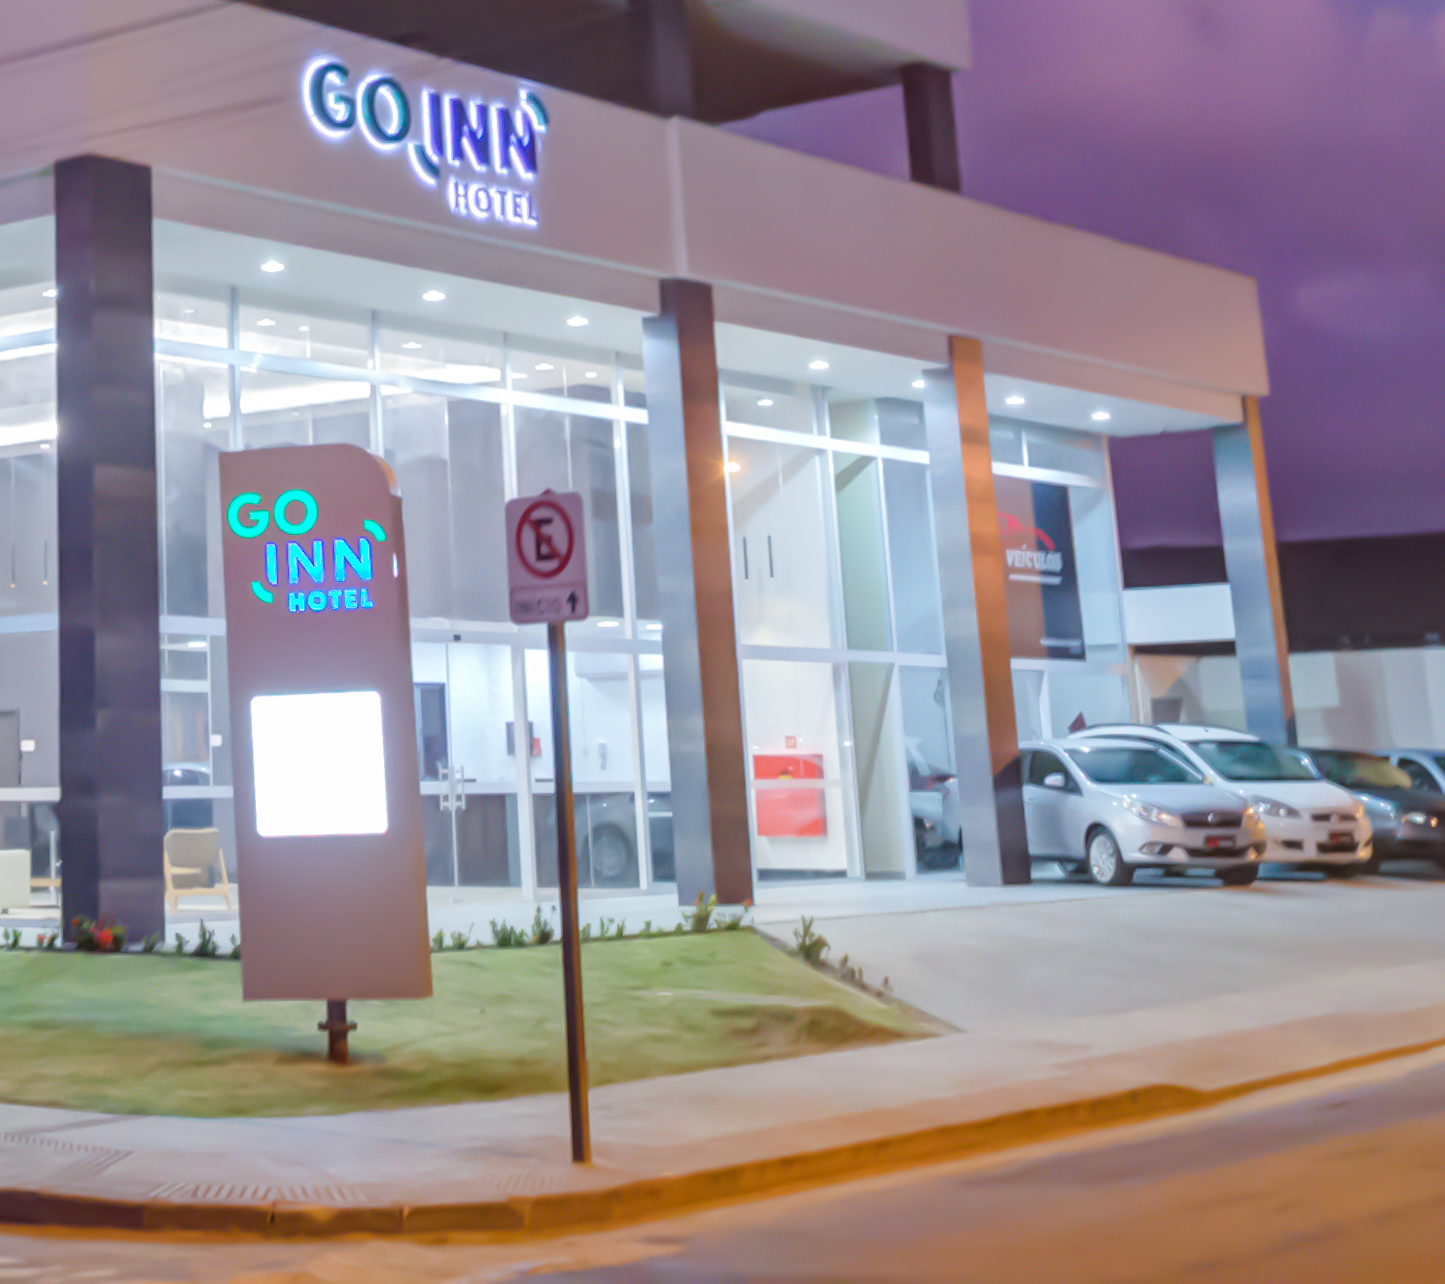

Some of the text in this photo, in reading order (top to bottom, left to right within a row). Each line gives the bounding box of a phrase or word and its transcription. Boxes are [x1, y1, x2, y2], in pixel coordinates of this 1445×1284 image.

[303, 58, 539, 182] GO INN
[447, 177, 539, 229] HOTEL
[227, 489, 318, 539] GO
[265, 537, 373, 587] INN
[533, 517, 559, 562] E
[287, 587, 375, 613] HOTEL
